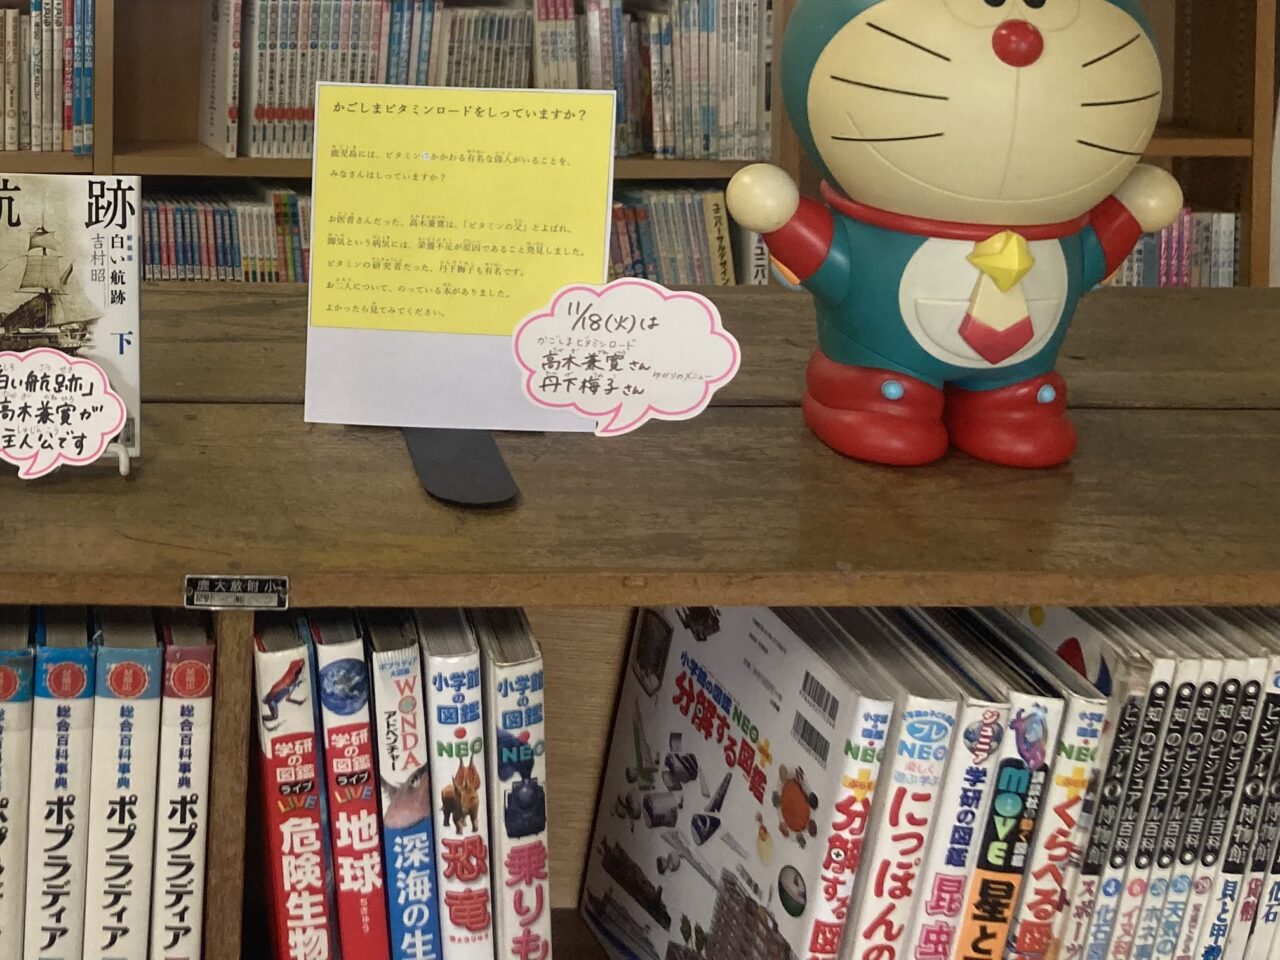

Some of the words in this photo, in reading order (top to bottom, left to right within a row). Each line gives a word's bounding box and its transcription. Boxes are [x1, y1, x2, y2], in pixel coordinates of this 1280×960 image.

[333, 102, 587, 121] かごしまビタミンロードをしっていますか？
[330, 169, 446, 182] みなさんはしっていますか？
[85, 179, 136, 230] 跡
[90, 233, 106, 283] 吉村昭
[110, 234, 126, 306] 白い航跡
[326, 304, 446, 318] よかったら見てみてください。
[110, 331, 133, 355] 下
[536, 336, 637, 350] かごしまビタミンロード
[538, 376, 645, 395] 丹下梅子さん
[2, 429, 87, 455] 主人公です
[394, 674, 422, 771] WONDA
[437, 701, 480, 725] 図鑑
[501, 704, 543, 729] 図鑑
[672, 670, 768, 805] 分解する図鑑
[732, 708, 760, 744] NEO
[912, 724, 947, 739] プレ
[55, 704, 71, 790] 総合百科事典
[117, 704, 134, 790] 総合百科事典
[179, 704, 195, 790] 総合百科事典
[275, 738, 313, 757] 学研
[331, 730, 368, 748] 学研
[383, 711, 399, 771] アドベンチャー
[437, 737, 483, 758] NEO
[897, 740, 949, 761] NEO
[333, 756, 371, 772] 図鑑
[501, 741, 544, 763] NEO
[276, 764, 314, 782] 図鑑
[337, 772, 369, 786] ライブ
[279, 782, 313, 794] ライブ
[335, 785, 373, 805] LIVE
[277, 796, 318, 813] LIVE
[987, 767, 1030, 867] MOVE
[335, 809, 382, 893] 地球
[40, 794, 76, 950] ポプラディア
[101, 794, 138, 950] ポプラディア
[163, 794, 198, 949] ポプラディア
[441, 835, 491, 932] 恐竜
[279, 816, 329, 960] 危険生物
[915, 872, 967, 960] 昆虫
